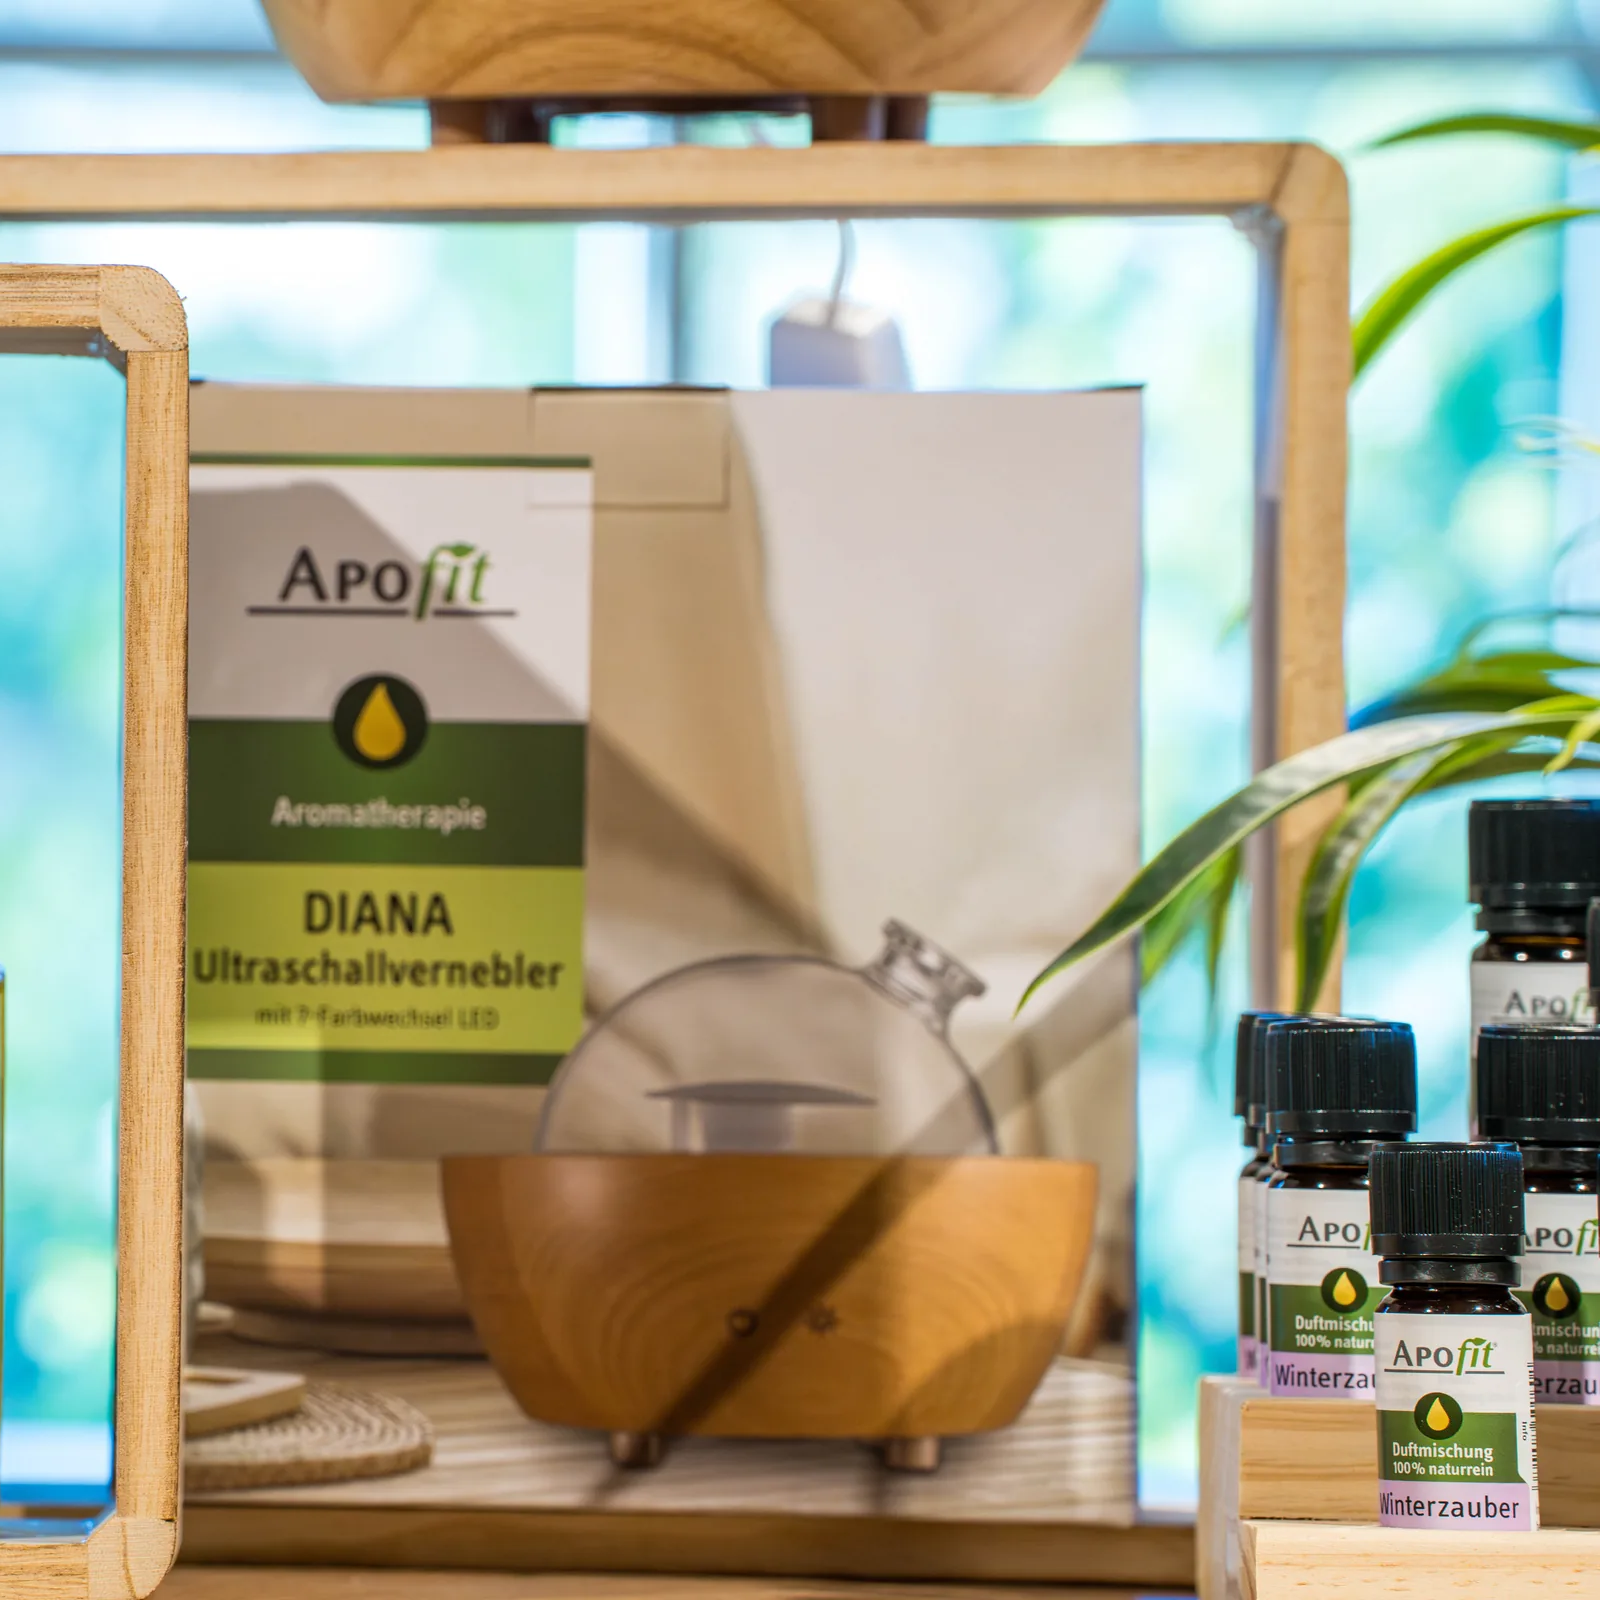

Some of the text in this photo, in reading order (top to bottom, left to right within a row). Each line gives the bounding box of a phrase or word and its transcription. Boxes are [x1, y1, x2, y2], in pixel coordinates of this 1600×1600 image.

[272, 797, 487, 834] Aromatherapie
[304, 890, 454, 938] DIANA
[193, 948, 564, 989] Ultraschallvernebler
[255, 1008, 291, 1025] mit
[1296, 1334, 1331, 1348] 100%
[1393, 1442, 1494, 1461] Duftmischung
[1393, 1462, 1493, 1476] 100% naturrein
[1380, 1493, 1519, 1519] Winterzauber
